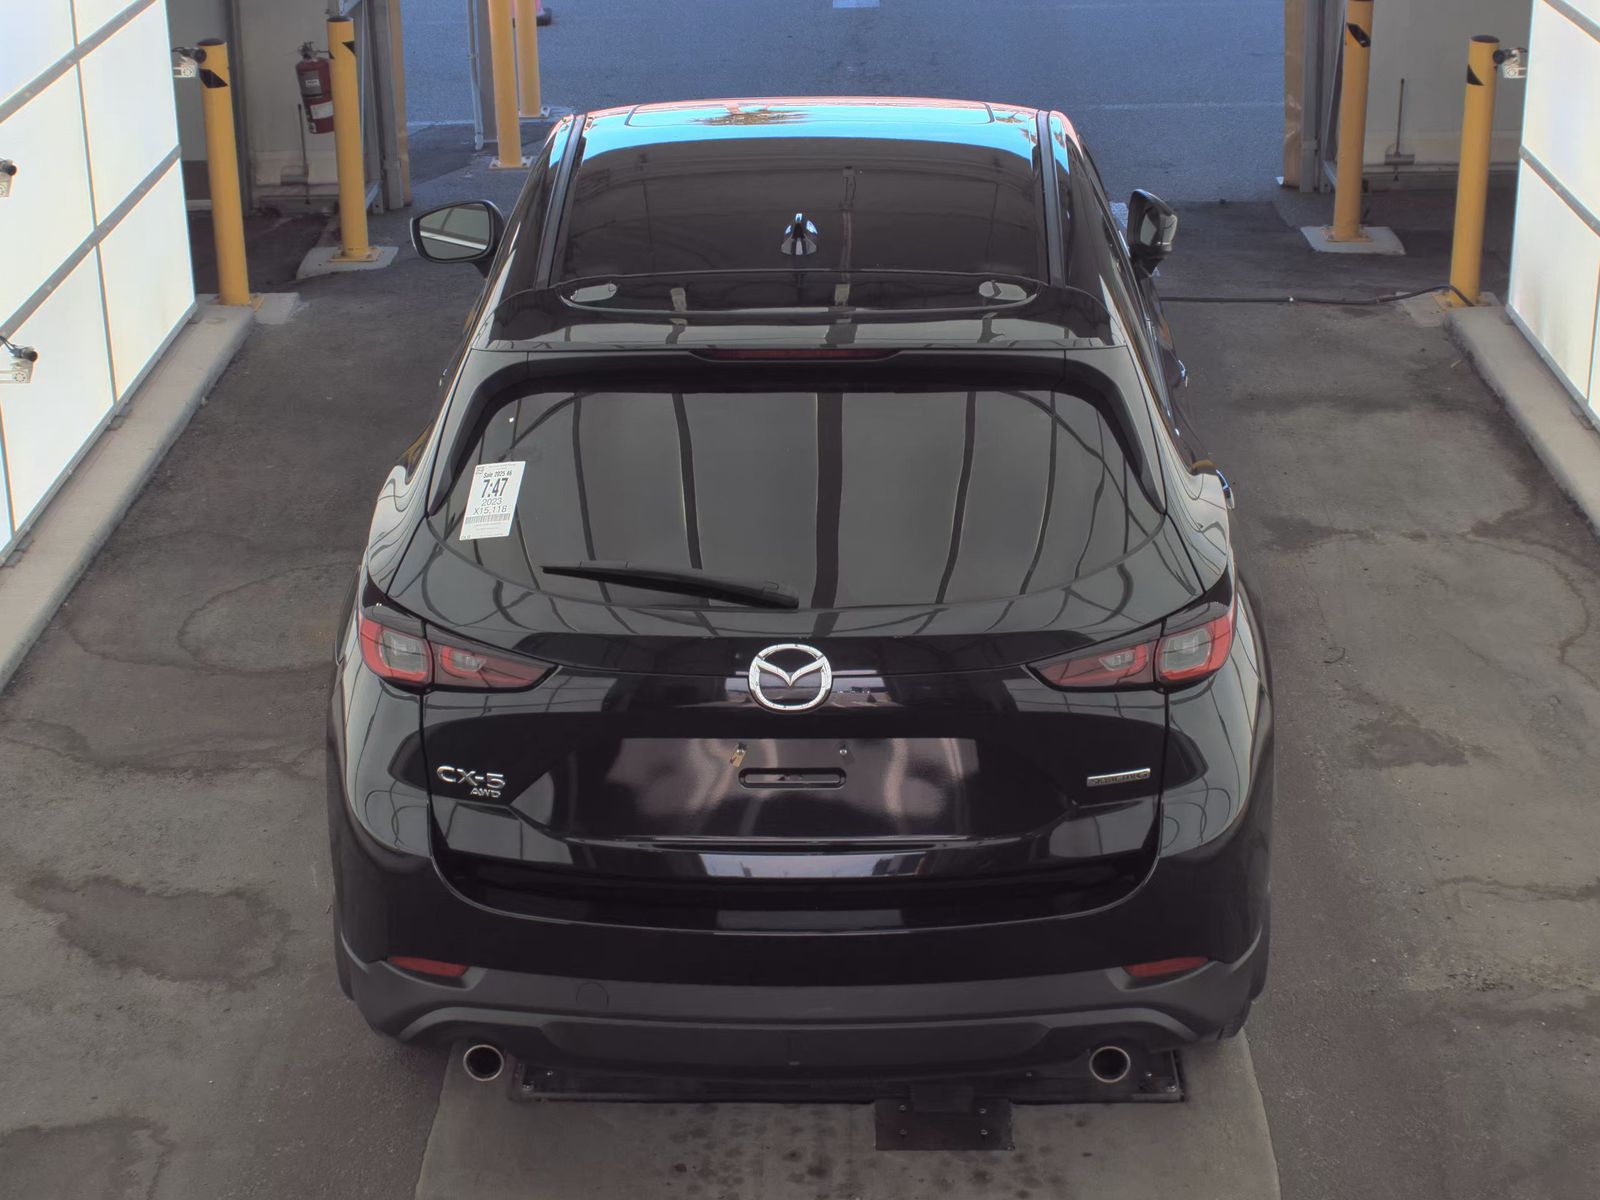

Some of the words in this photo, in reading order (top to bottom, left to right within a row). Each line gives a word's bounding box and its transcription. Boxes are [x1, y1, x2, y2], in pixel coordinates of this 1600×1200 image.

[481, 498, 502, 506] 2023
[436, 765, 506, 789] CX-5
[470, 787, 501, 798] AWD
